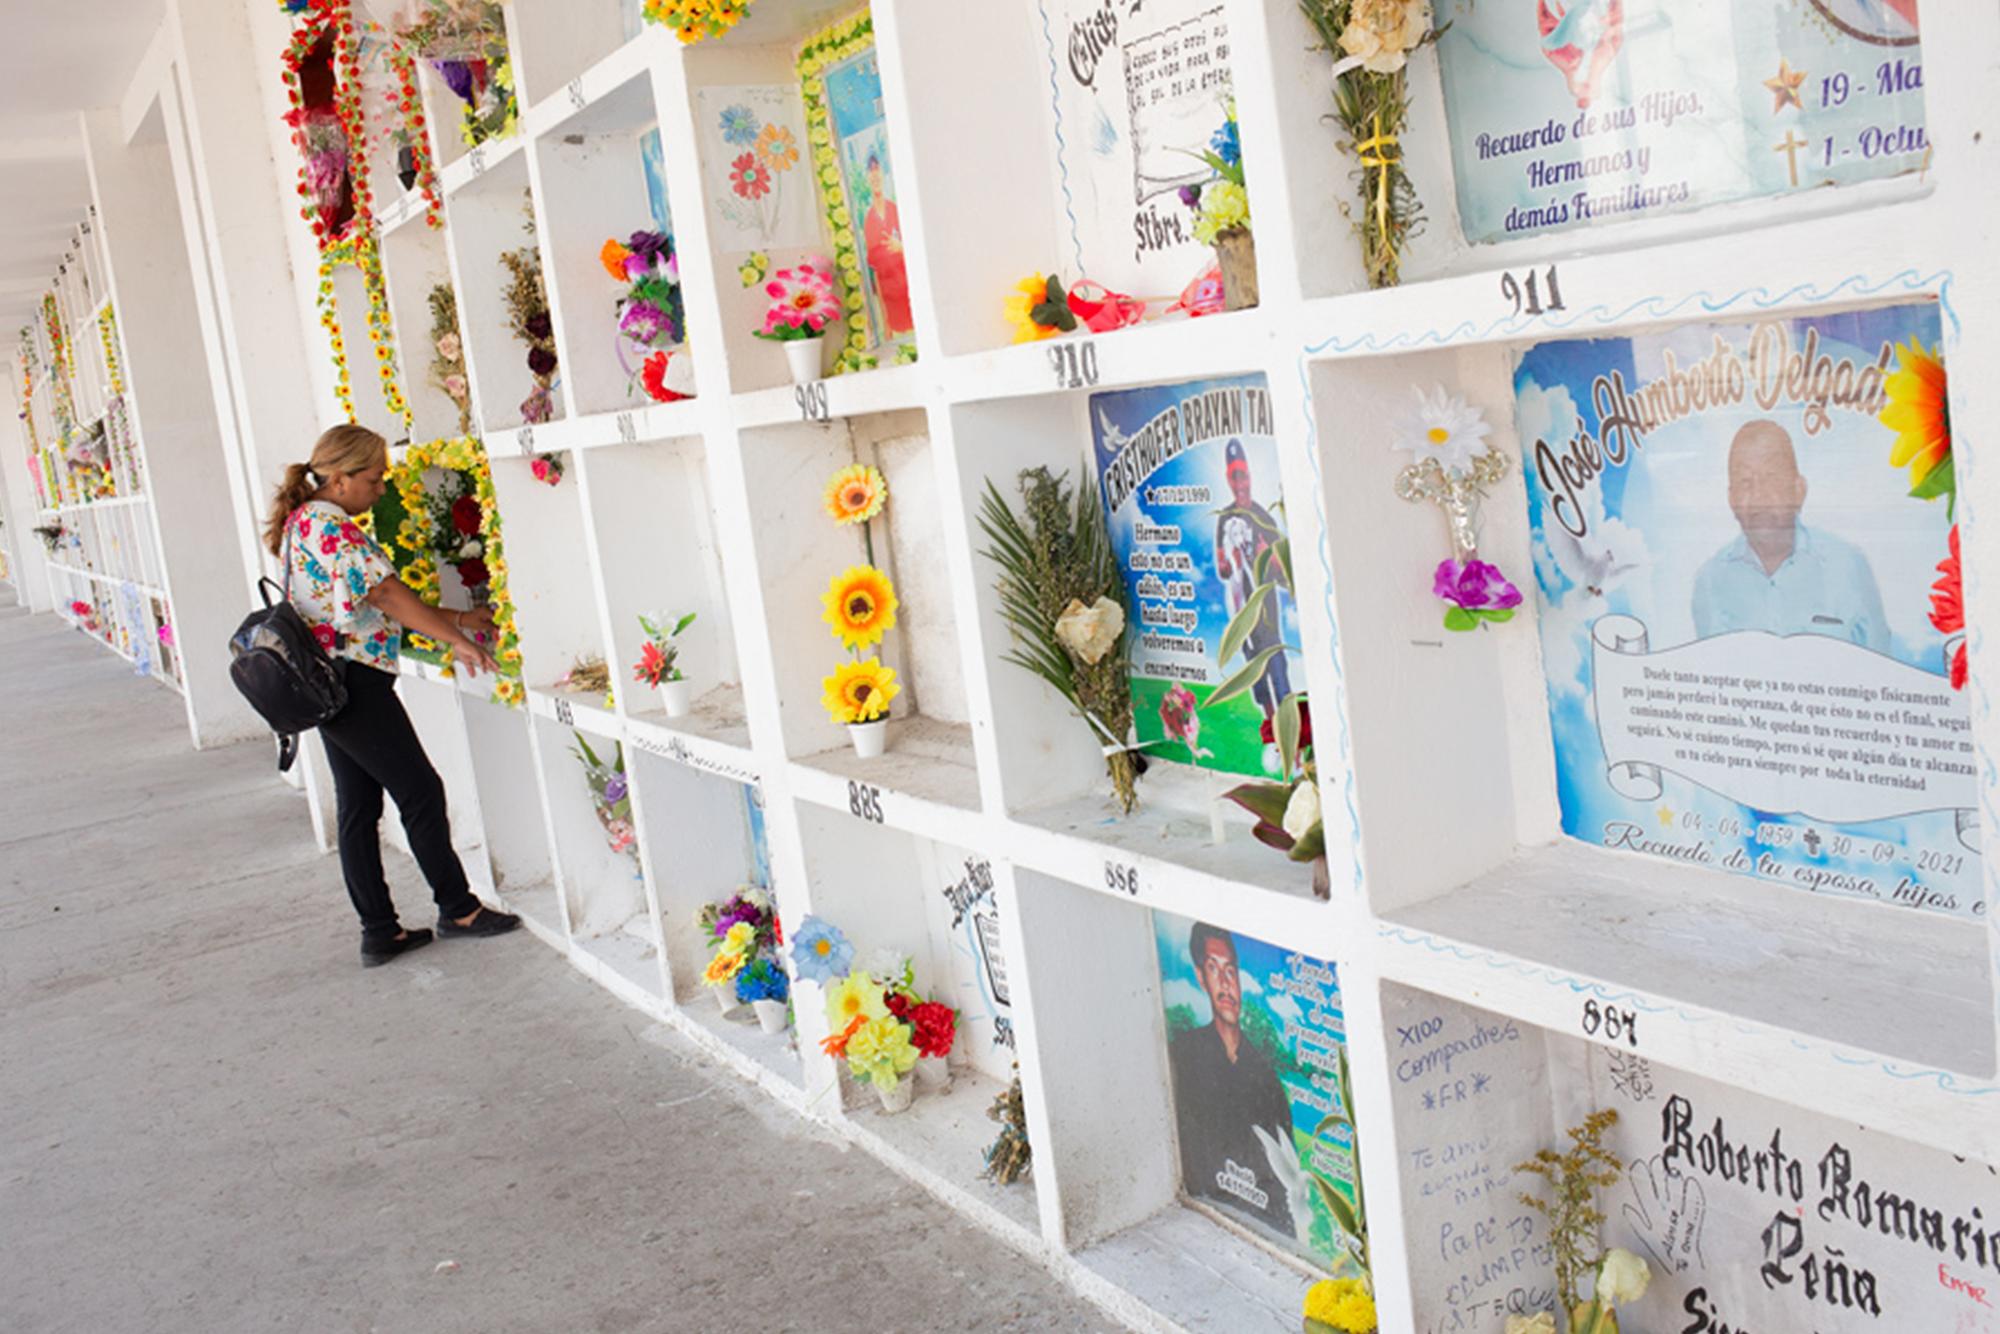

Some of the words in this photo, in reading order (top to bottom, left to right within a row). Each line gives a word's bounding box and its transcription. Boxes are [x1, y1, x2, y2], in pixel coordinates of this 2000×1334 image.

[1822, 72, 1850, 108] 19
[1475, 118, 1566, 160] Recuerdo
[1572, 111, 1597, 140] de
[1601, 106, 1636, 133] sus
[1640, 90, 1704, 128] Hijos,
[1824, 135, 1834, 167] 1
[1858, 125, 1930, 159] Octu
[1527, 149, 1633, 188] Hermanos
[1637, 147, 1651, 176] y
[1505, 197, 1569, 233] demás
[1570, 180, 1690, 220] Familiares
[1501, 265, 1567, 319] 911
[1048, 341, 1099, 388] 910
[796, 382, 830, 422] 909
[1534, 417, 1601, 538] José
[1592, 334, 1746, 466] Humberto
[1749, 319, 1894, 437] Delgad
[1104, 406, 1182, 514] CRISTHOFER
[1182, 389, 1244, 447] BRAYAN
[1135, 523, 1180, 542] Hermano
[1130, 553, 1149, 570] esto
[1150, 555, 1164, 568] no
[1165, 555, 1175, 569] es
[1176, 556, 1190, 570] un
[1168, 583, 1179, 597] es
[1180, 584, 1194, 598] un
[1142, 602, 1167, 624] hasta
[1168, 606, 1197, 630] luego
[1142, 631, 1196, 653] volveremos
[1623, 686, 1644, 699] pero
[1719, 693, 1729, 706] la
[1731, 698, 1789, 714] esperanza,
[1791, 701, 1804, 714] de
[1806, 704, 1828, 718] que
[1856, 708, 1871, 721] no
[1874, 710, 1886, 722] es
[1889, 711, 1900, 725] el
[1902, 711, 1936, 728] final,
[1643, 667, 1671, 682] Duele
[1674, 671, 1700, 684] tanto
[1702, 675, 1741, 689] aceptar
[1743, 679, 1762, 692] que
[1765, 681, 1779, 693] ya
[1781, 681, 1795, 693] no
[1827, 685, 1878, 702] conmigo
[1630, 705, 1683, 721] caminando
[1685, 710, 1705, 724] este
[1750, 715, 1768, 730] Me
[1770, 719, 1811, 736] quedan
[1813, 723, 1832, 738] tus
[1834, 728, 1892, 745] recuerdos
[1894, 734, 1902, 749] y
[1905, 734, 1919, 748] tu
[1921, 737, 1956, 752] amor
[1667, 725, 1681, 740] No
[1732, 734, 1773, 751] tiempo,
[1774, 740, 1799, 756] pero
[1827, 748, 1850, 763] que
[1910, 756, 1923, 770] te
[1702, 749, 1727, 765] cielo
[1728, 754, 1752, 769] para
[1754, 755, 1797, 775] siempre
[1800, 763, 1819, 778] por
[1825, 765, 1851, 782] toda
[1853, 768, 1866, 784] la
[1868, 771, 1927, 792] eternidad
[848, 780, 884, 825] 885
[1682, 812, 1701, 832] 04
[1718, 817, 1740, 838] 04
[1831, 834, 1853, 856] 30
[1872, 841, 1896, 864] 09
[1915, 849, 1965, 876] 2021
[1722, 846, 1751, 872] de
[1756, 851, 1786, 879] tu
[1793, 866, 1882, 898] esposa,
[1891, 877, 1963, 914] hijos
[1583, 998, 1637, 1047] 887
[1661, 1094, 1802, 1202] Roberto
[1760, 1209, 1881, 1318] Peña
